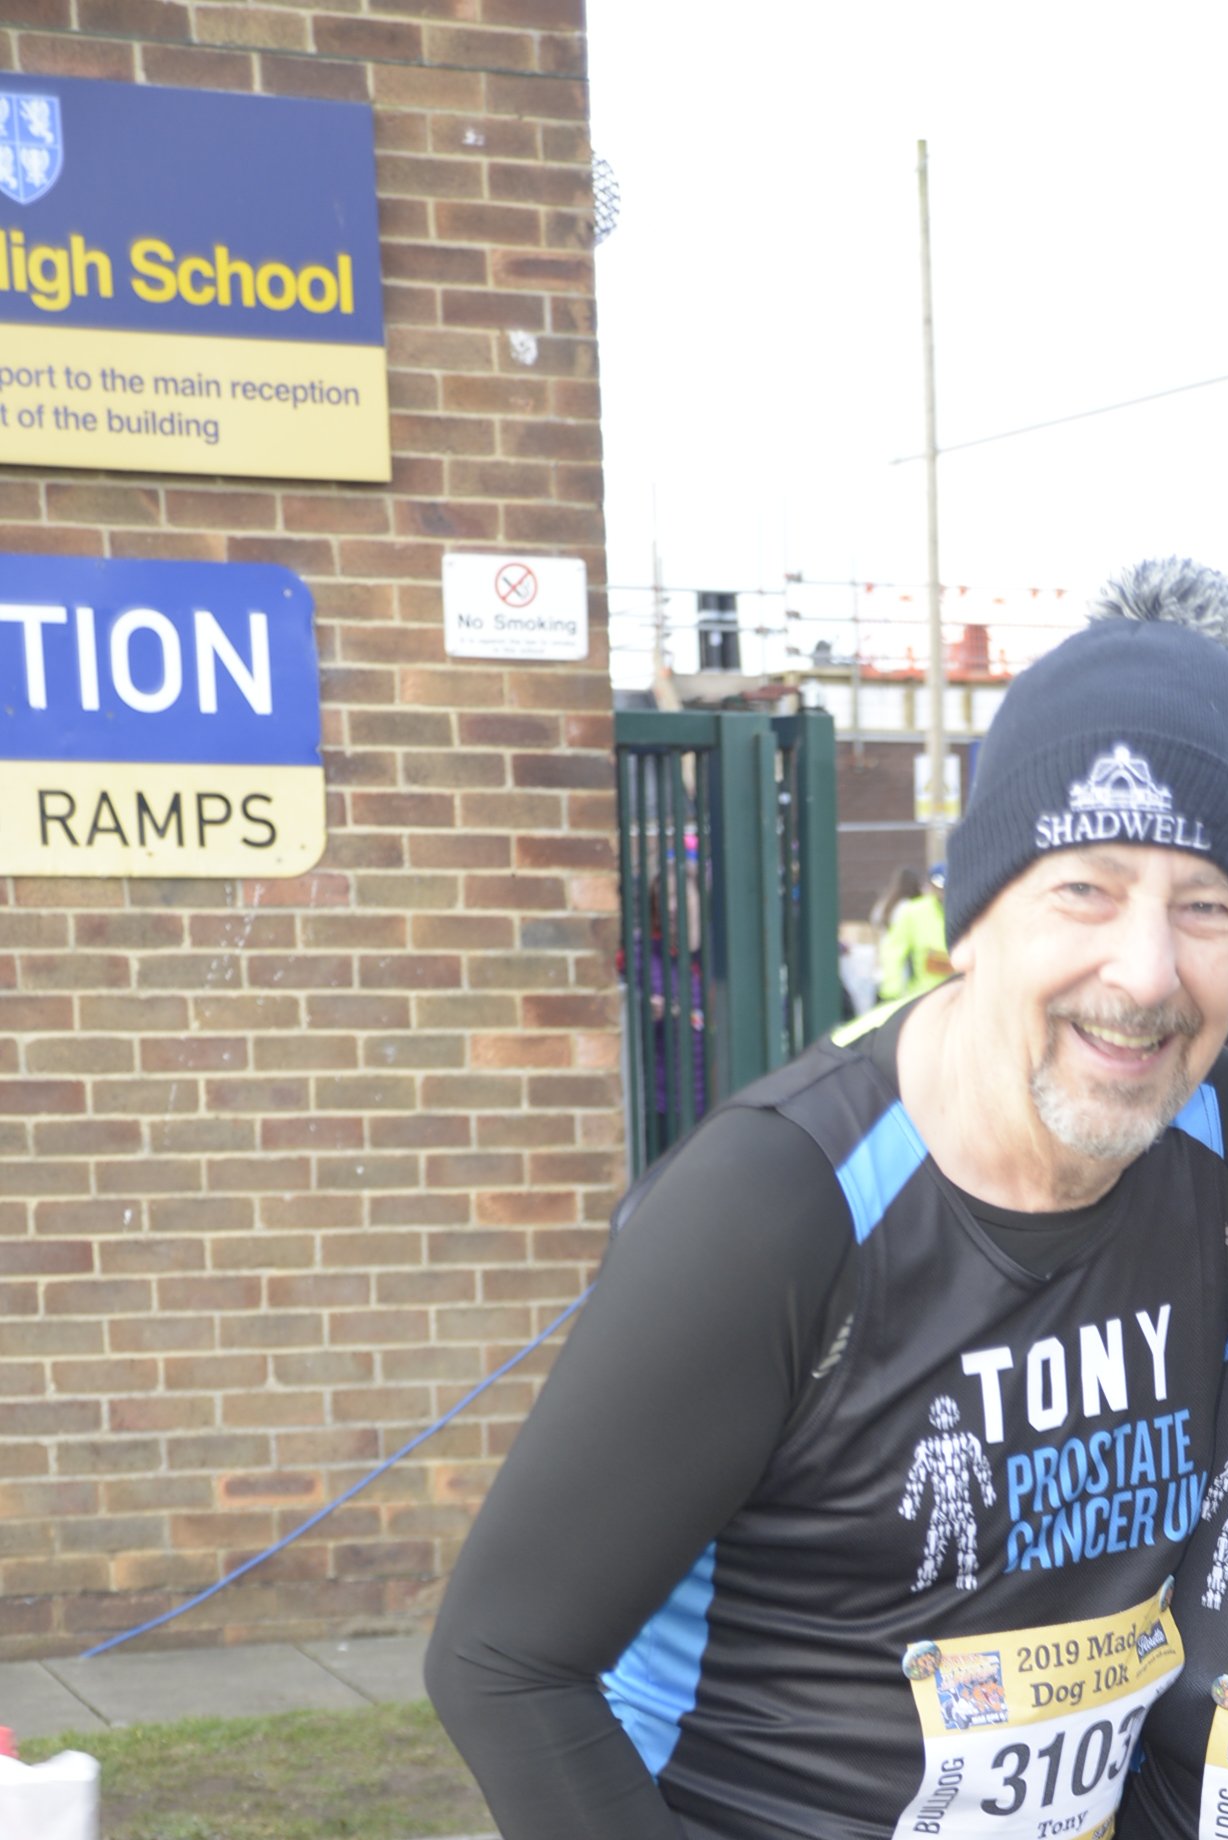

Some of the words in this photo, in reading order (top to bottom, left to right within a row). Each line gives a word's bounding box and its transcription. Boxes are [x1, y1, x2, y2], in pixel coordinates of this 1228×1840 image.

[130, 237, 355, 315] School
[64, 366, 92, 391] to
[100, 368, 144, 394] the
[153, 371, 222, 400] main
[230, 373, 360, 410] reception
[17, 404, 45, 430] of
[53, 406, 98, 433] the
[106, 408, 220, 445] building
[458, 613, 484, 630] No
[494, 614, 577, 635] Smoking
[0, 604, 273, 715] TION
[38, 789, 278, 849] RAMPS
[1035, 810, 1212, 850] SHADWELL
[961, 1303, 1172, 1444] TONY
[1006, 1408, 1195, 1522] PROSTATE
[1002, 1487, 1159, 1575] CANCER
[1017, 1640, 1080, 1673] 2019
[1087, 1622, 1137, 1661] Mad
[1030, 1680, 1085, 1708] Dog
[1093, 1663, 1130, 1694] 10k
[913, 1756, 965, 1835] BULLDOG
[1037, 1809, 1088, 1840] Tony
